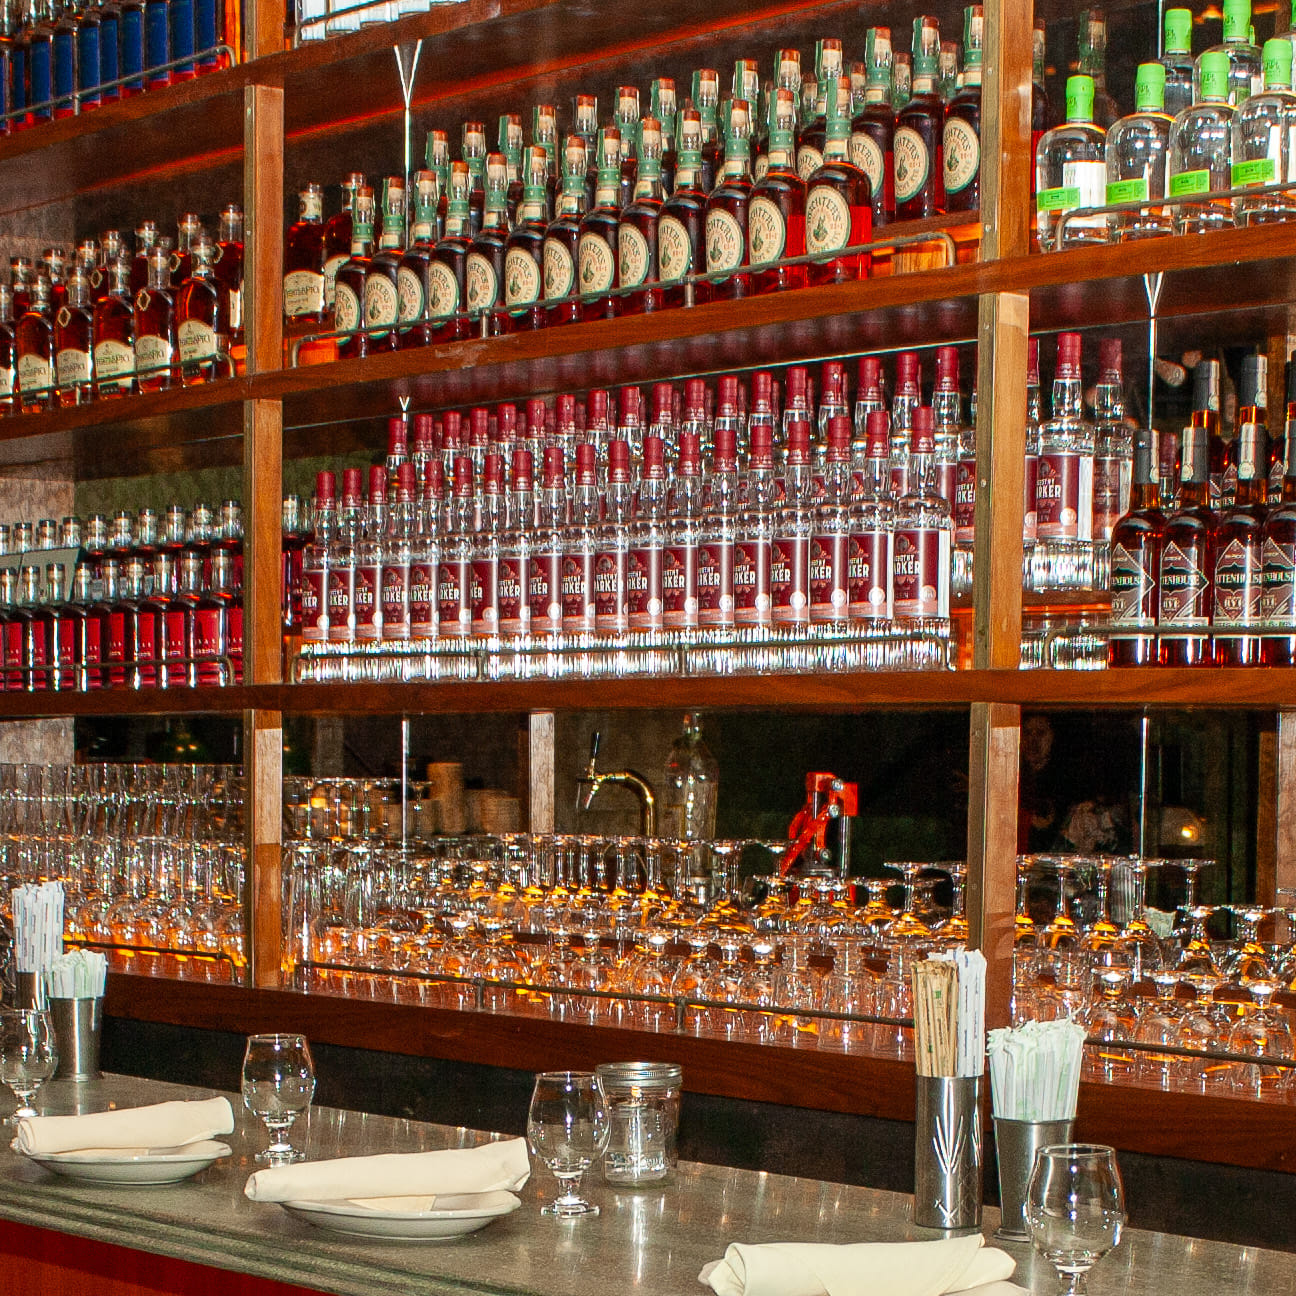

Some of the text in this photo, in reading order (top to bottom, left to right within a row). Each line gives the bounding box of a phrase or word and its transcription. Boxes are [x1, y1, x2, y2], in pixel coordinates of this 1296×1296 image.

[956, 489, 976, 503] RKE
[1037, 484, 1061, 499] RKER
[810, 566, 832, 580] RKER
[895, 560, 921, 576] RKER
[663, 575, 685, 589] RKER
[734, 571, 756, 585] RKER
[772, 569, 791, 583] RKER
[594, 579, 624, 592] ARKER
